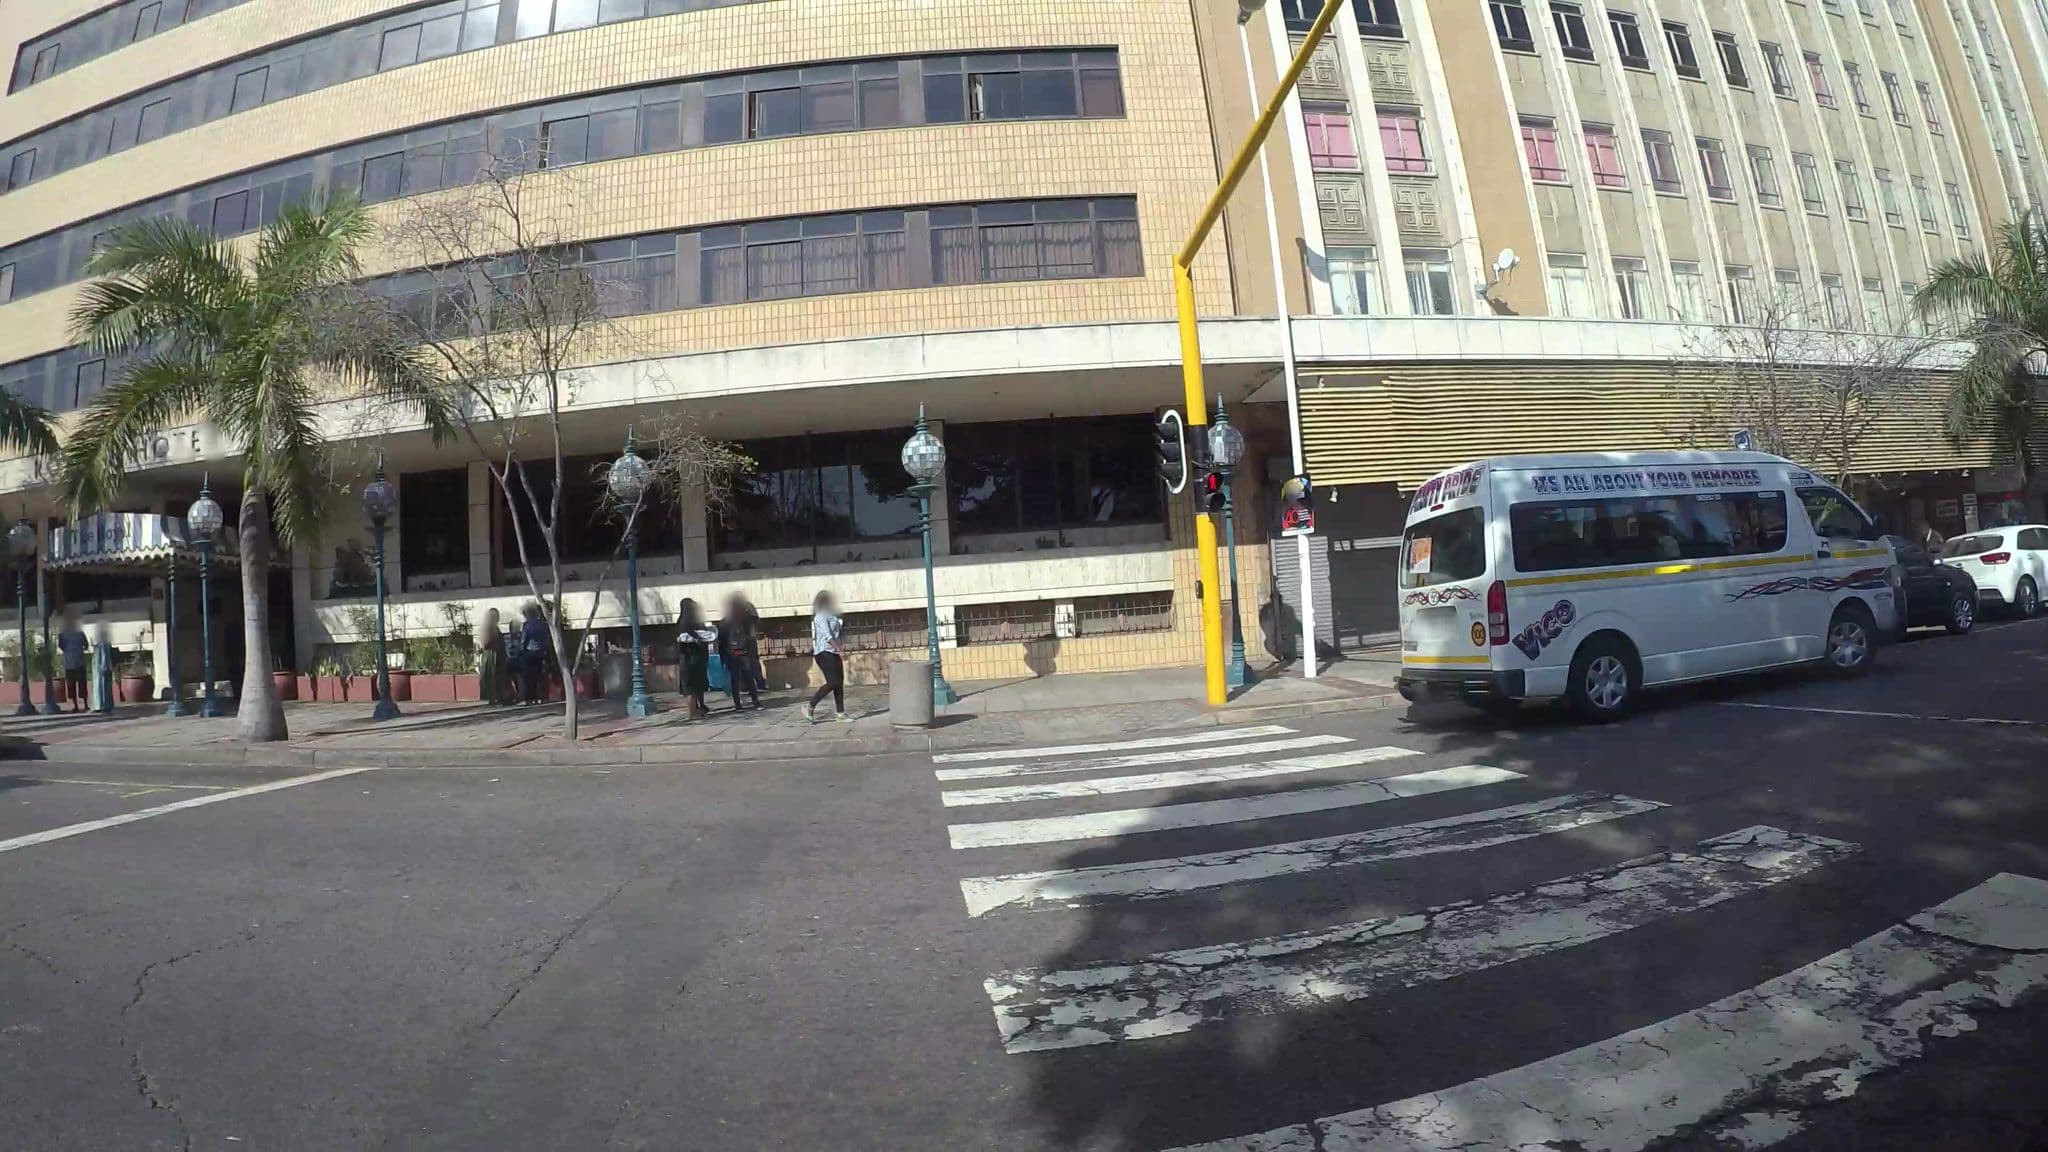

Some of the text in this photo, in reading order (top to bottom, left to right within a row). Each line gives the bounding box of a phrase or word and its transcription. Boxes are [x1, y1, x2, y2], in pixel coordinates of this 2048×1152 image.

[1563, 475, 1591, 493] ALL
[1593, 471, 1643, 492] ABOUT
[1647, 471, 1691, 489] YOUR
[1692, 469, 1761, 488] MEMORIES
